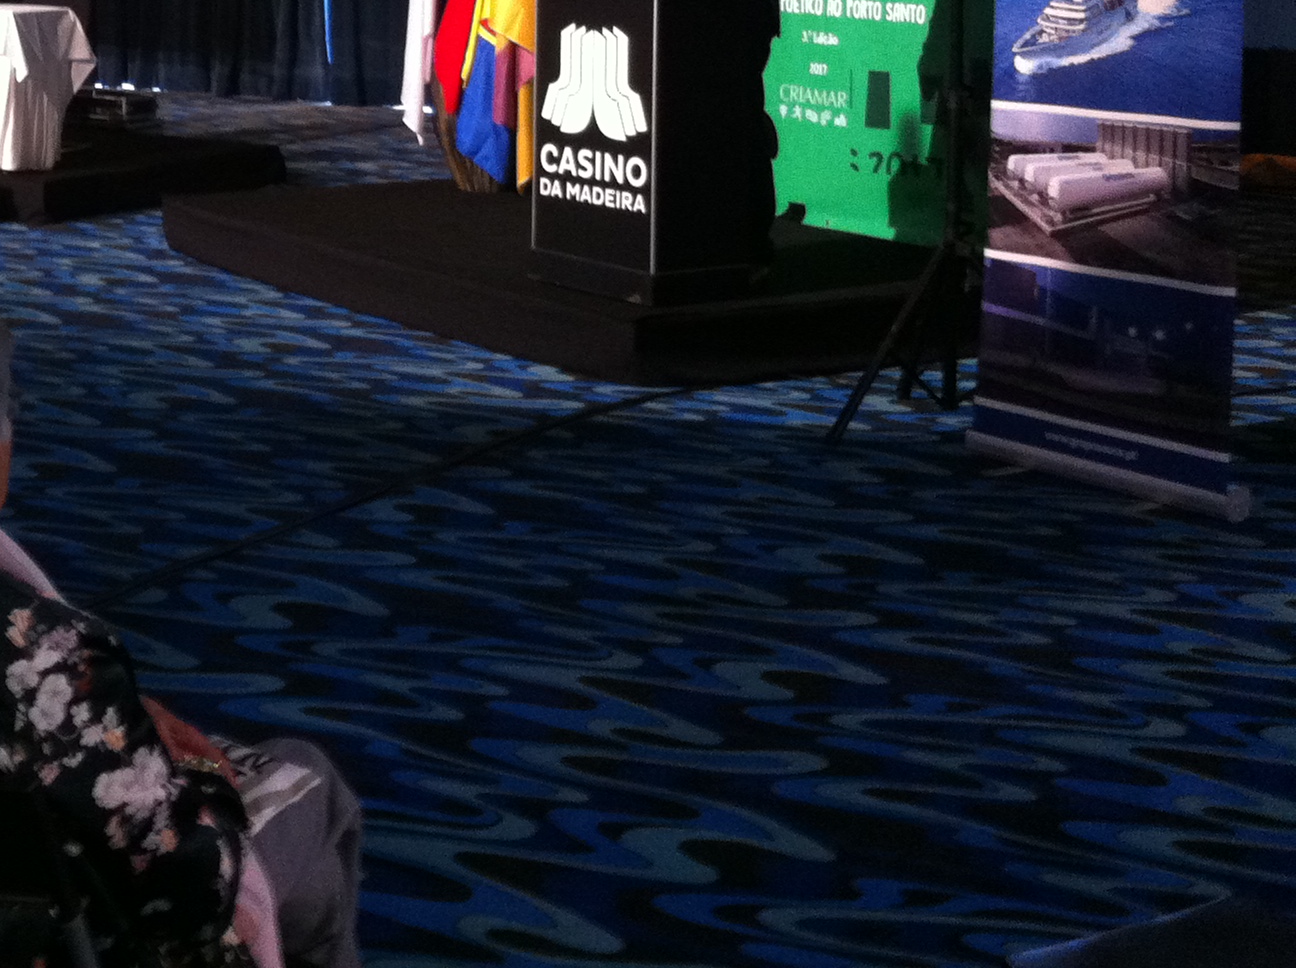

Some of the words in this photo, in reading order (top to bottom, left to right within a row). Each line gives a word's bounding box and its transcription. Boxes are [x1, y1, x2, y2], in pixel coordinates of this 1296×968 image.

[885, 1, 927, 25] SANTO
[779, 83, 848, 109] CRIAMAR
[540, 143, 647, 188] CASINO
[539, 176, 563, 199] DA
[565, 180, 646, 214] MADEIRA
